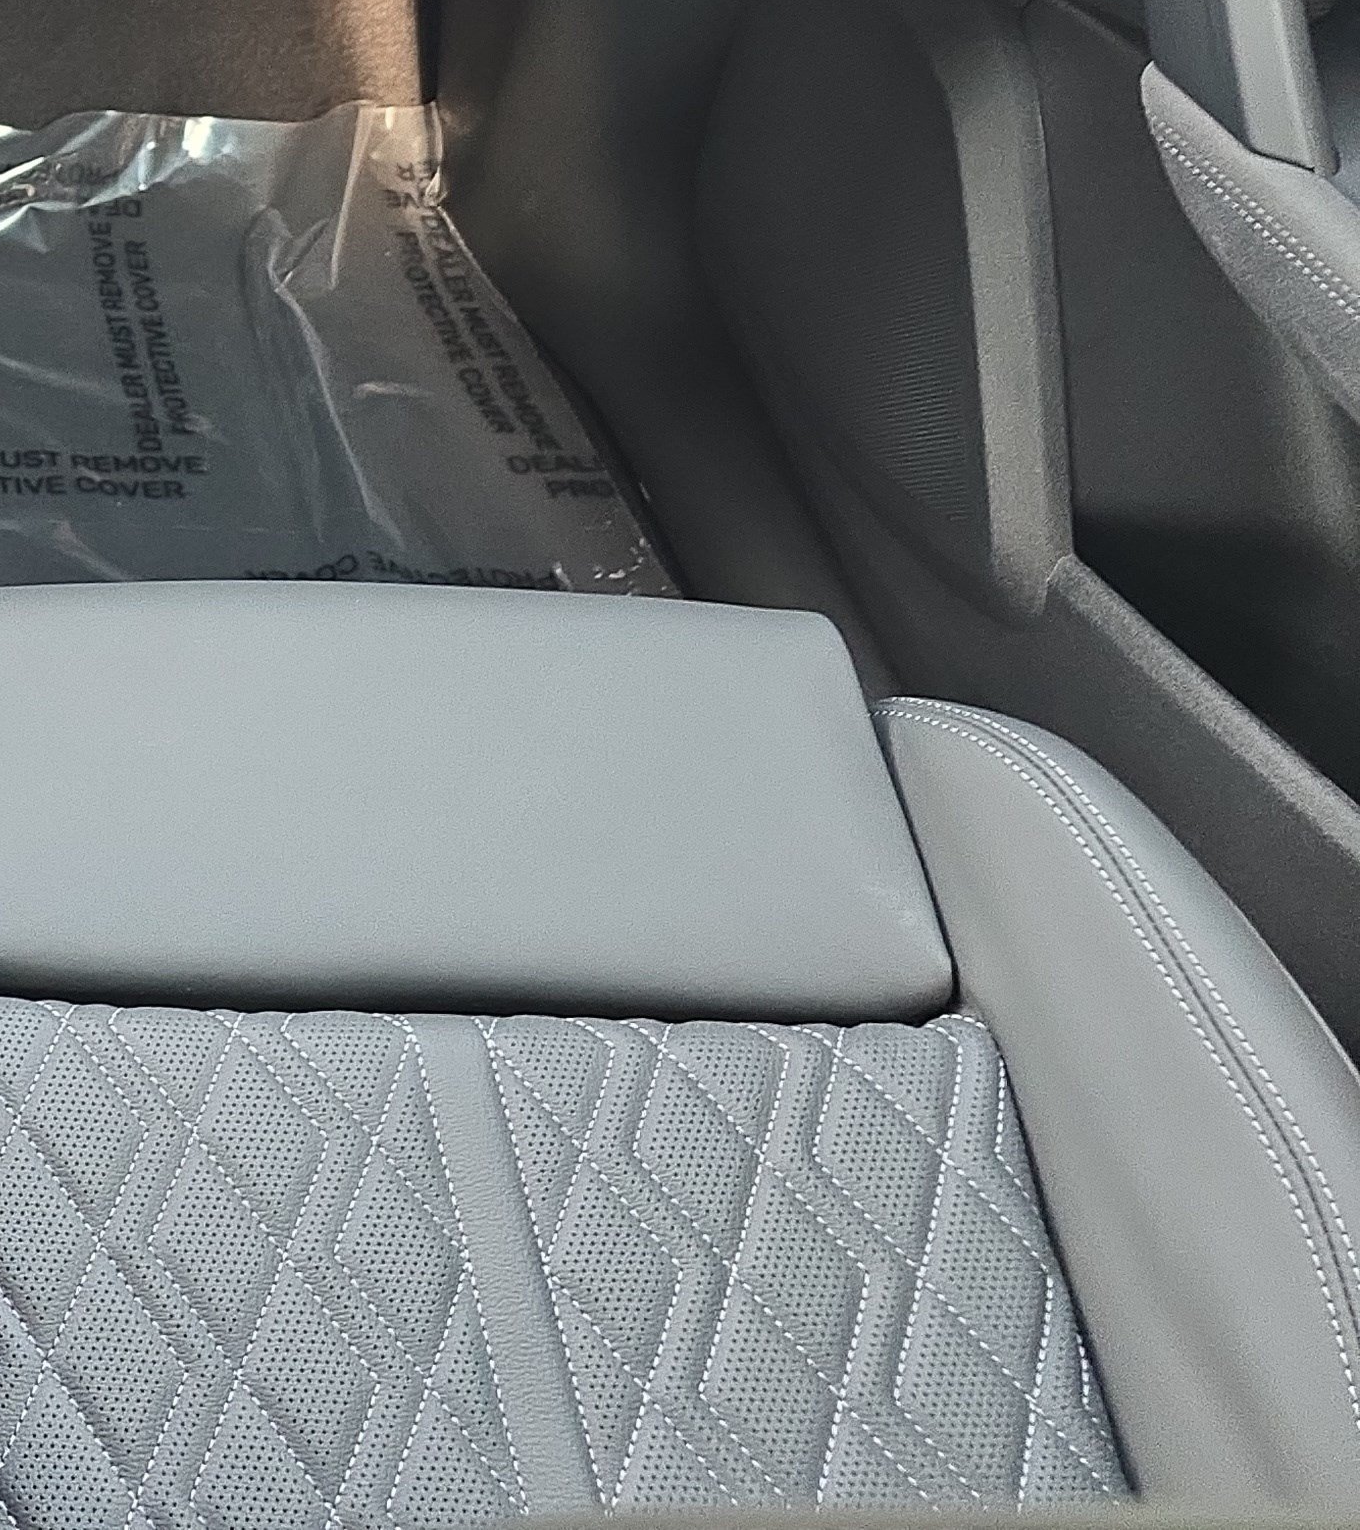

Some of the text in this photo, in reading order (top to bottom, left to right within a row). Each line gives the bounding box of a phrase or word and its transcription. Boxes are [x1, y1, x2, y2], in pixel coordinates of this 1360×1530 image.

[88, 220, 123, 311] REMOVE
[124, 238, 160, 313] COVER
[70, 453, 207, 475] REMOVE
[74, 475, 186, 501] COVER
